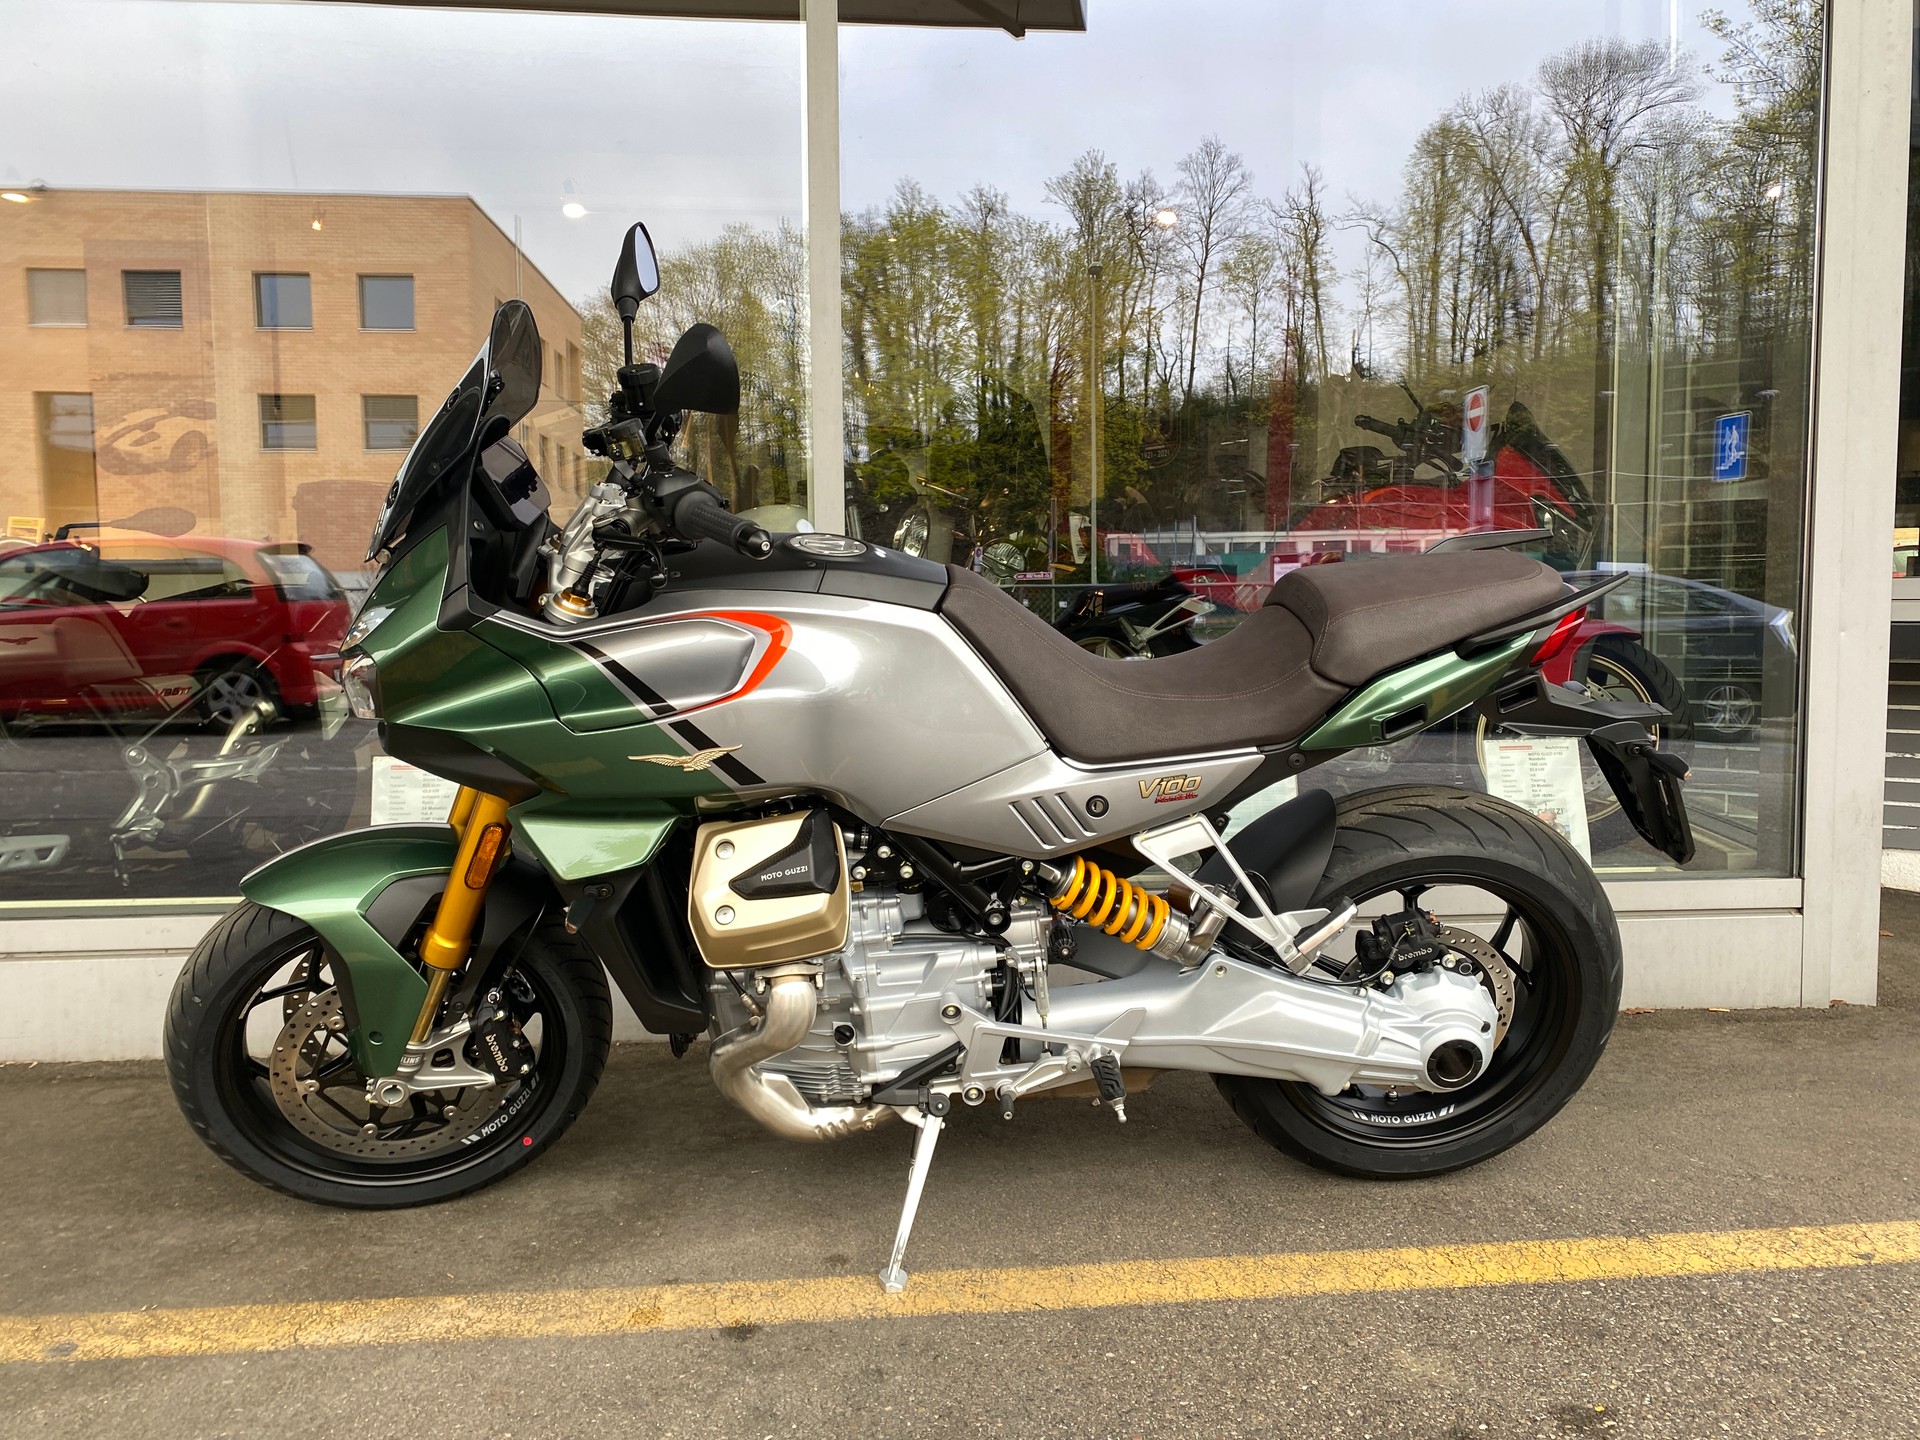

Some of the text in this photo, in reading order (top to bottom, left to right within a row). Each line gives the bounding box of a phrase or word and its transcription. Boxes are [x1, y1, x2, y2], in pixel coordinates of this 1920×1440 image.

[1138, 775, 1203, 799] V100
[760, 865, 808, 882] MOTO GUZZI
[1398, 947, 1433, 962] brembo
[485, 1033, 509, 1073] brembo
[481, 1087, 532, 1137] MOTO GUZZI
[1370, 1110, 1437, 1124] MOTO GUZZI
